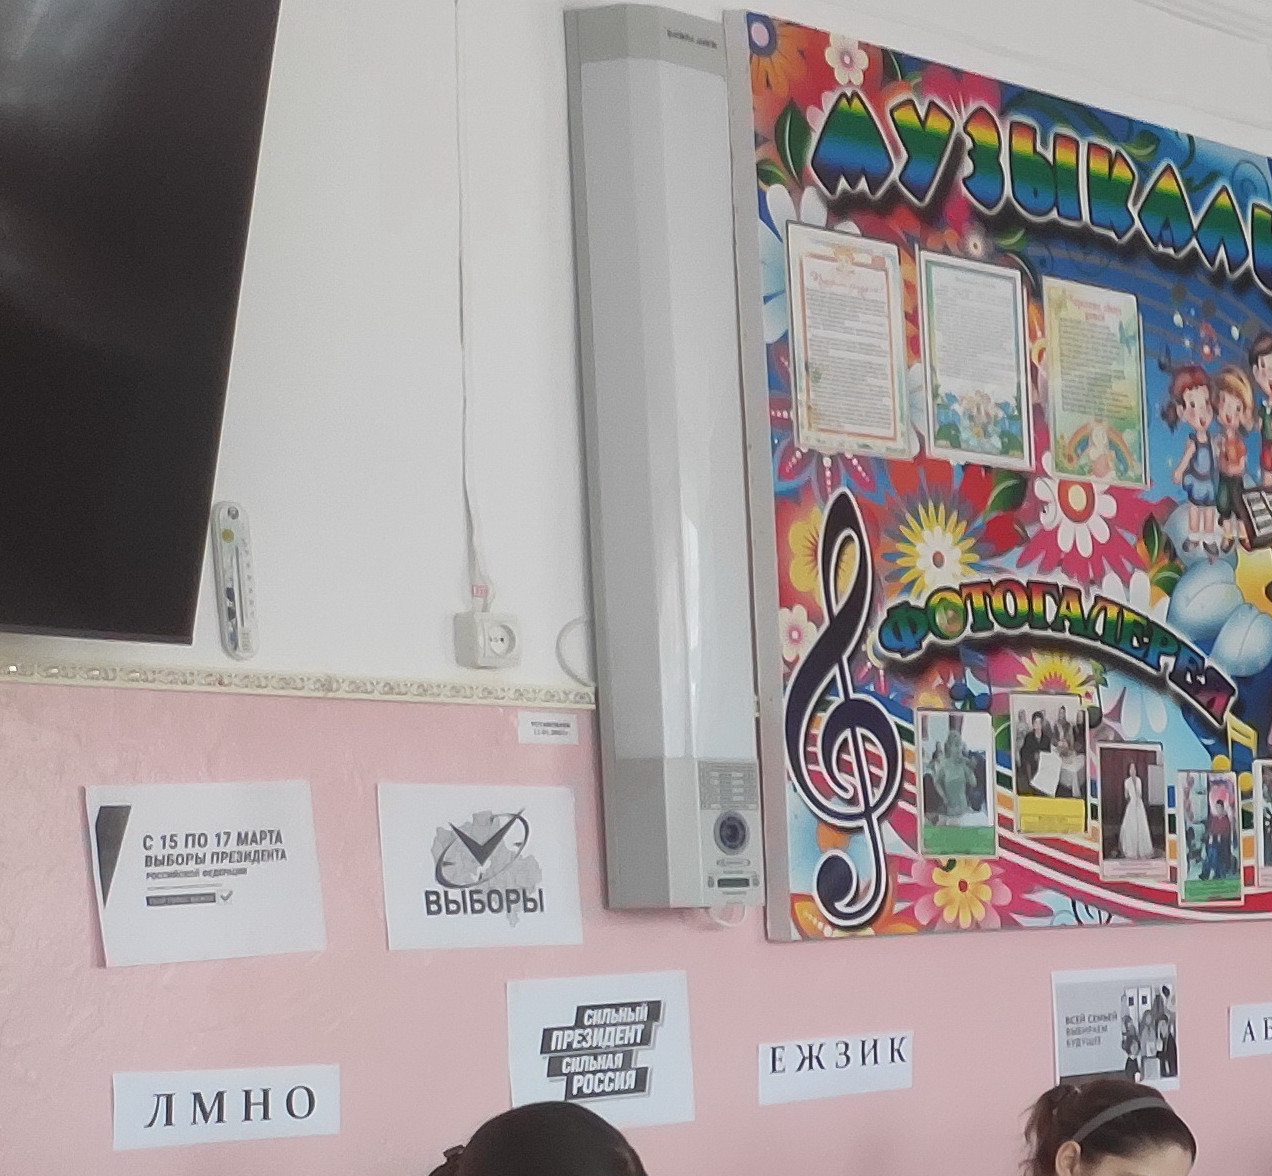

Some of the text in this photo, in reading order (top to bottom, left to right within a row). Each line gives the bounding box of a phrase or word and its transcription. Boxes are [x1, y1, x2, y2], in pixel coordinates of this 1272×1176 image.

[877, 578, 1238, 728] ФОТОГАЛЕРЕЯ
[143, 829, 283, 850] С 15 ПО 17 МАРТА
[145, 849, 288, 868] ВЫБОРЫ ПРЕЗИДЕНТА
[424, 888, 545, 916] ВЫБОРЫ
[583, 1003, 649, 1026] СИЛЬНЫЙ
[550, 1024, 645, 1051] ПРЕЗИДЕНТ
[561, 1052, 624, 1074] СИЛЬНАЯ
[571, 1069, 637, 1096] РОССИЯ
